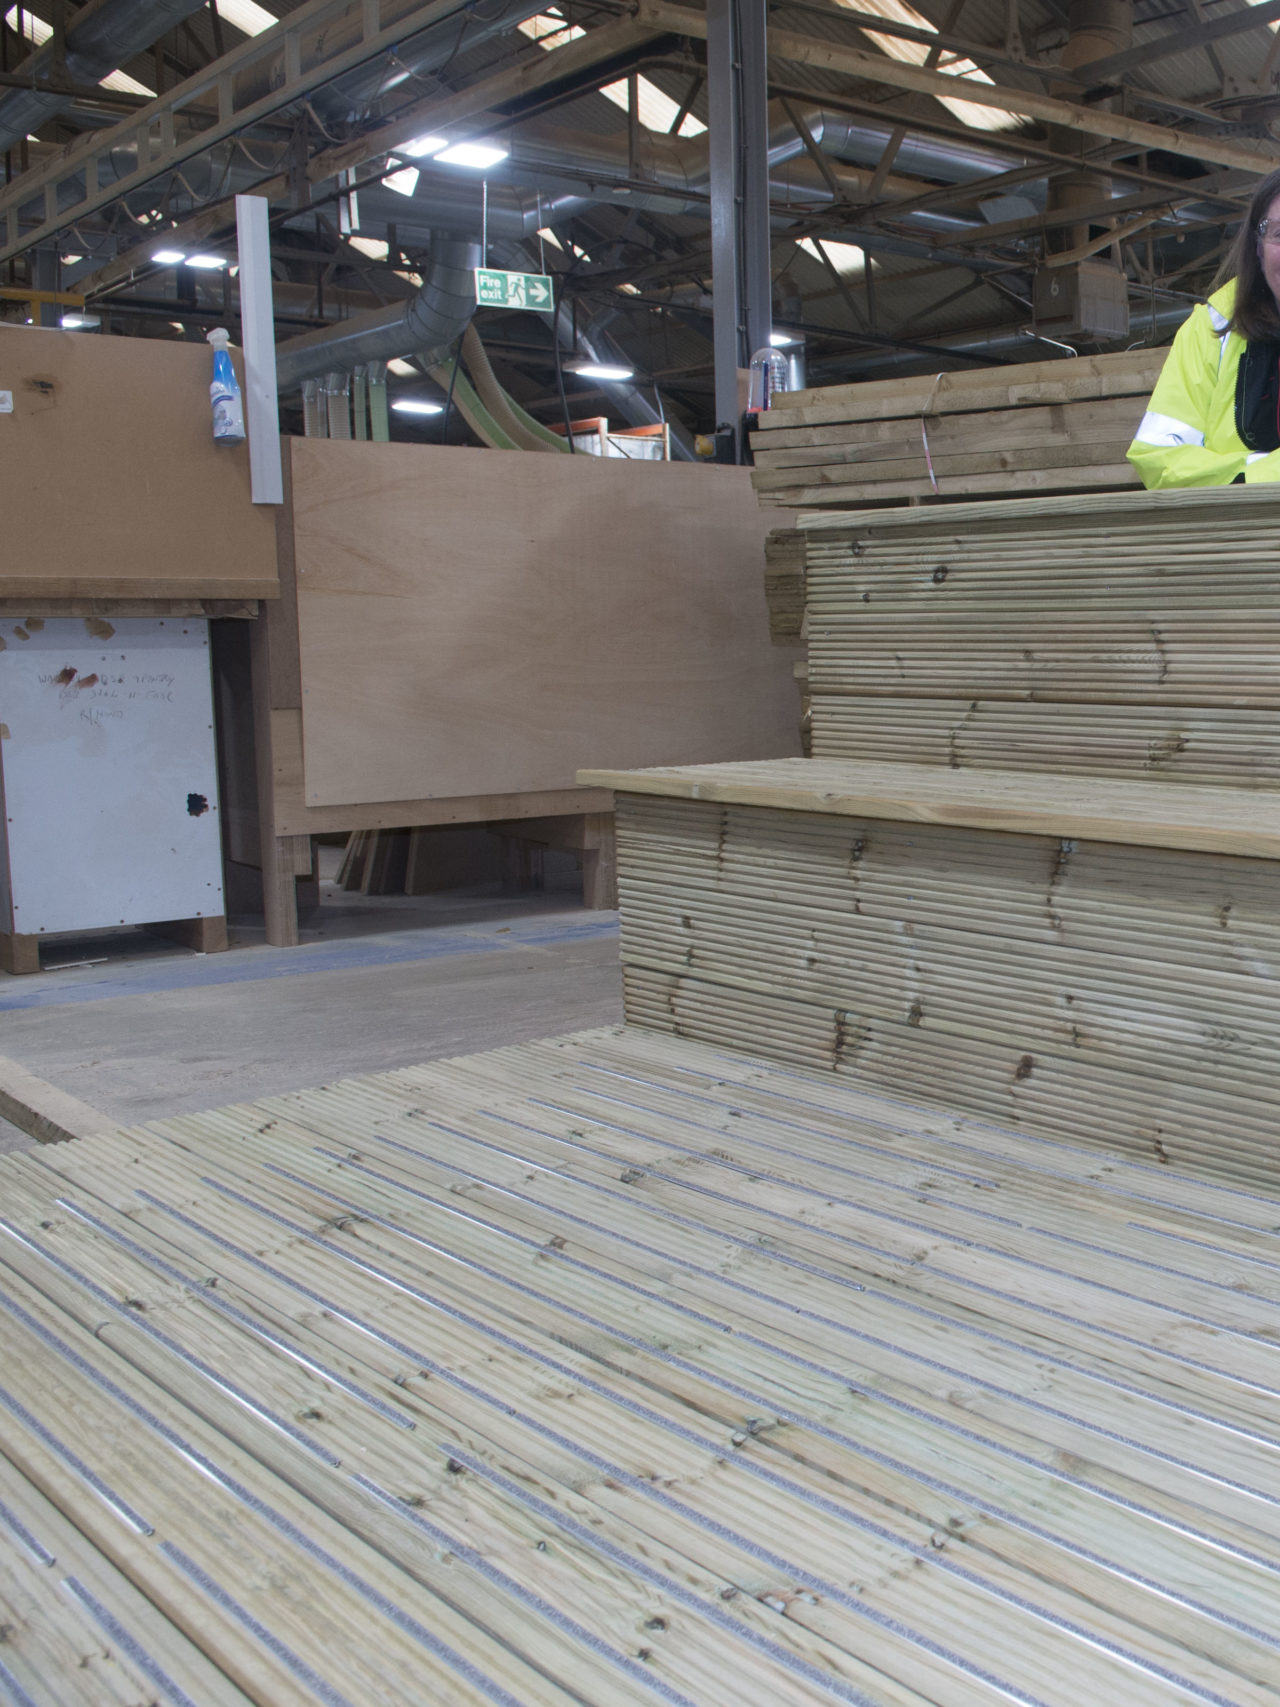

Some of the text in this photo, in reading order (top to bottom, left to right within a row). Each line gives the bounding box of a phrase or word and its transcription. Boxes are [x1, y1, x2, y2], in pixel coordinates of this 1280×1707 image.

[480, 275, 501, 288] Fire
[1050, 276, 1060, 297] 6
[480, 288, 502, 300] exit
